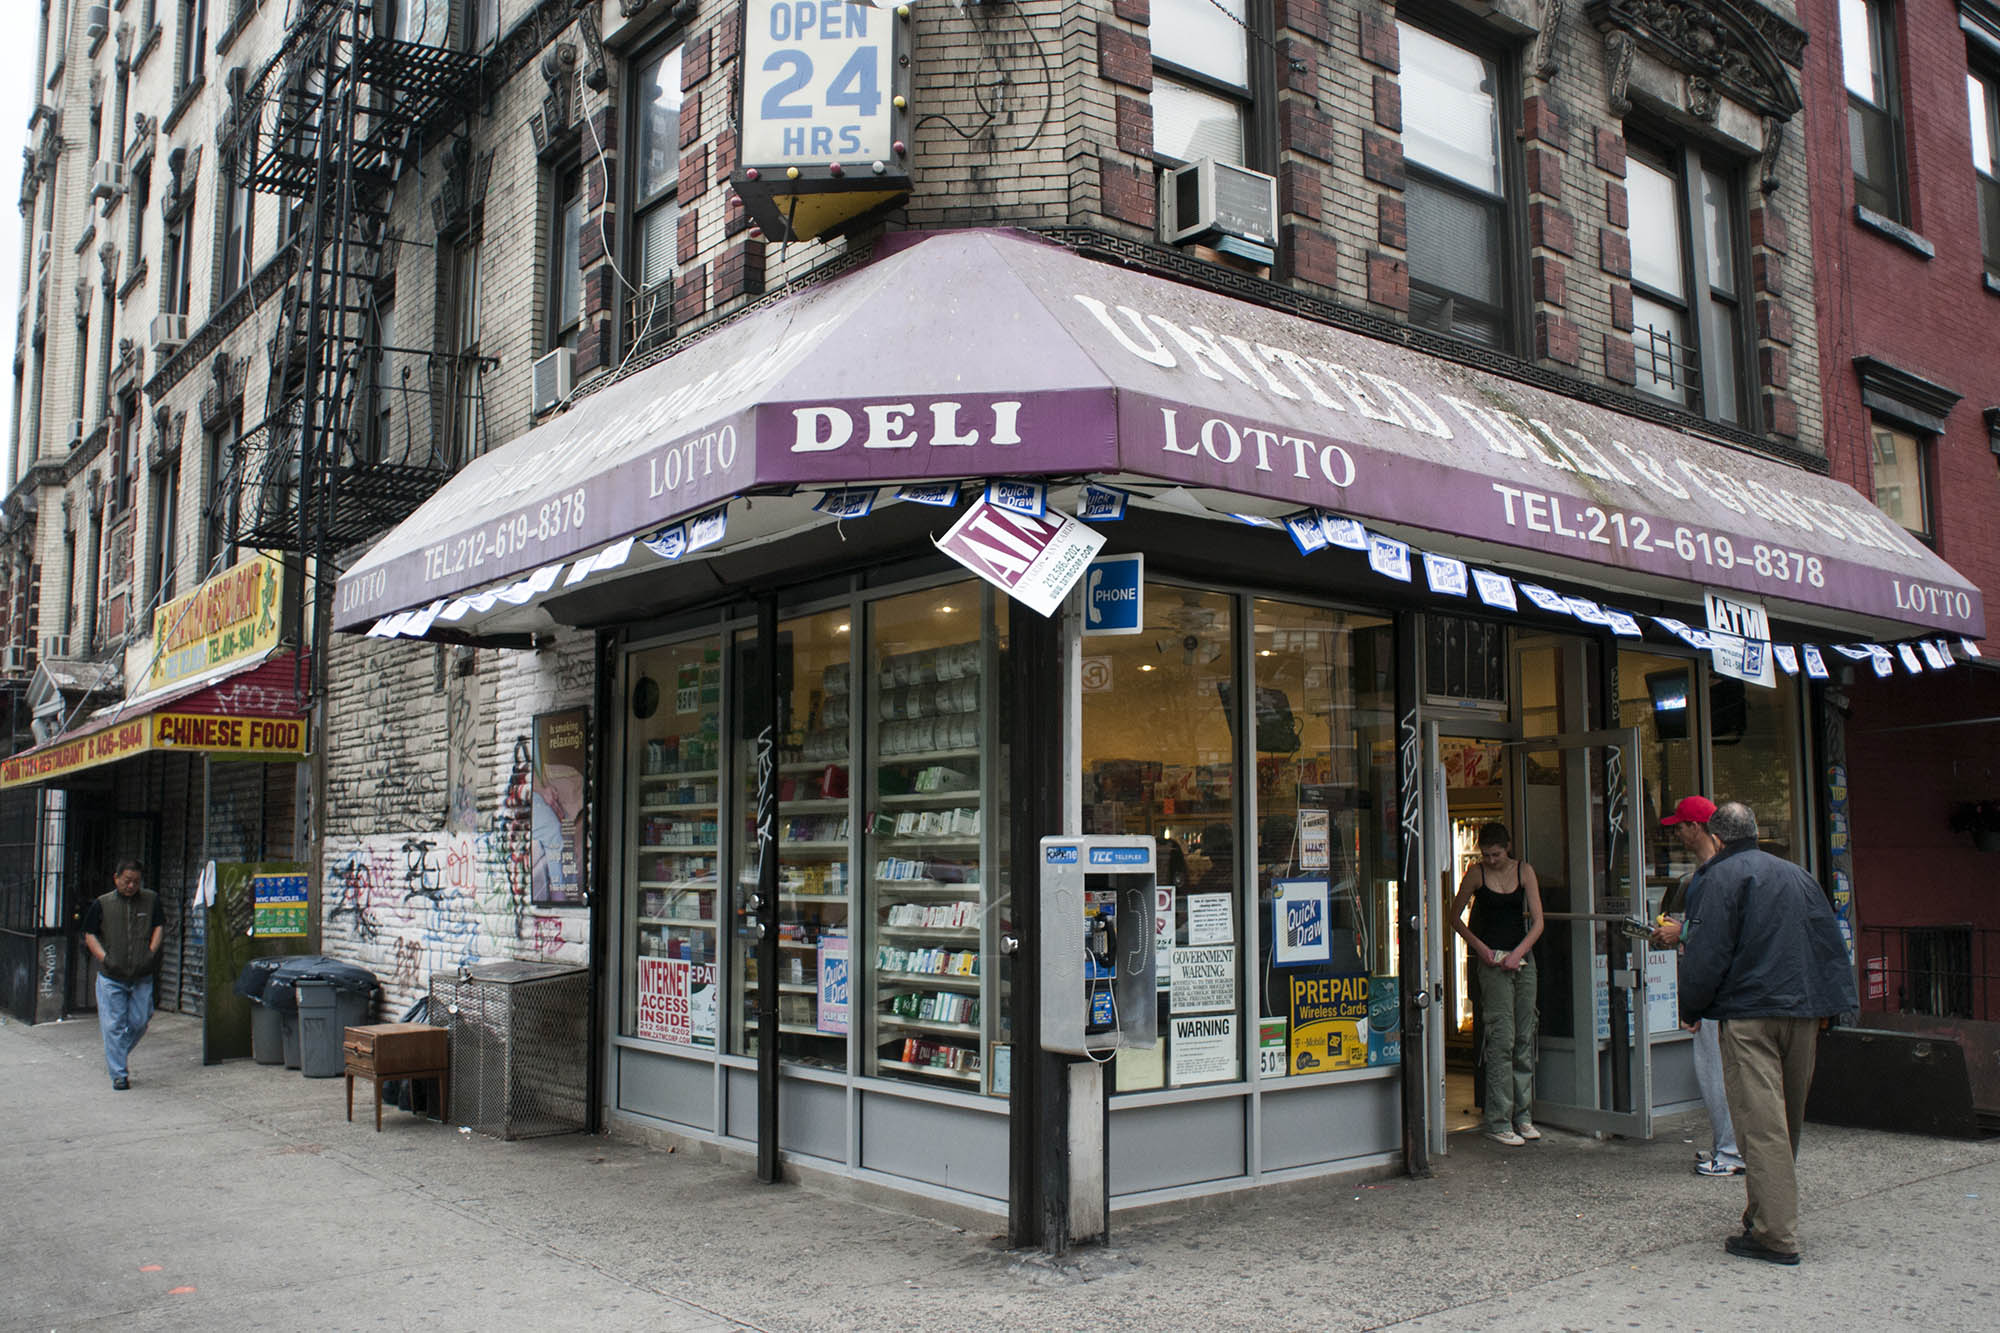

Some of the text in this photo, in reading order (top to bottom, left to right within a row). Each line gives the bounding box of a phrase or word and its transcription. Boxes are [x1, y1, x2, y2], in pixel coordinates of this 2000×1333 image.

[770, 1, 867, 40] OPEN
[761, 46, 881, 120] 24
[783, 125, 869, 156] HRS.
[1073, 294, 1454, 440] UNITED
[791, 401, 1022, 453] DELI
[648, 424, 737, 499] LOTTO
[1160, 408, 1356, 487] LOTTO
[1000, 485, 1029, 498] Quick
[1007, 497, 1033, 508] Draw
[1492, 483, 1825, 589] TEL:212-619-8378
[342, 568, 386, 613] LOTTO
[1096, 588, 1136, 601] PHONE
[1892, 579, 1972, 620] LOTTO
[1713, 597, 1762, 639] ATM
[158, 717, 299, 748] CHINESE FOOD
[550, 731, 584, 750] relaxing?
[1288, 897, 1316, 931] Quick
[1297, 921, 1321, 947] Draw
[1172, 950, 1233, 965] GOVERNMENT
[640, 959, 689, 997] INTERNET
[1295, 977, 1369, 1005] PREPAID
[640, 1009, 690, 1028] INSIDE
[641, 994, 688, 1014] ACCESS
[1300, 1002, 1367, 1019] Wireless Cards
[1177, 1018, 1230, 1038] WARNING
